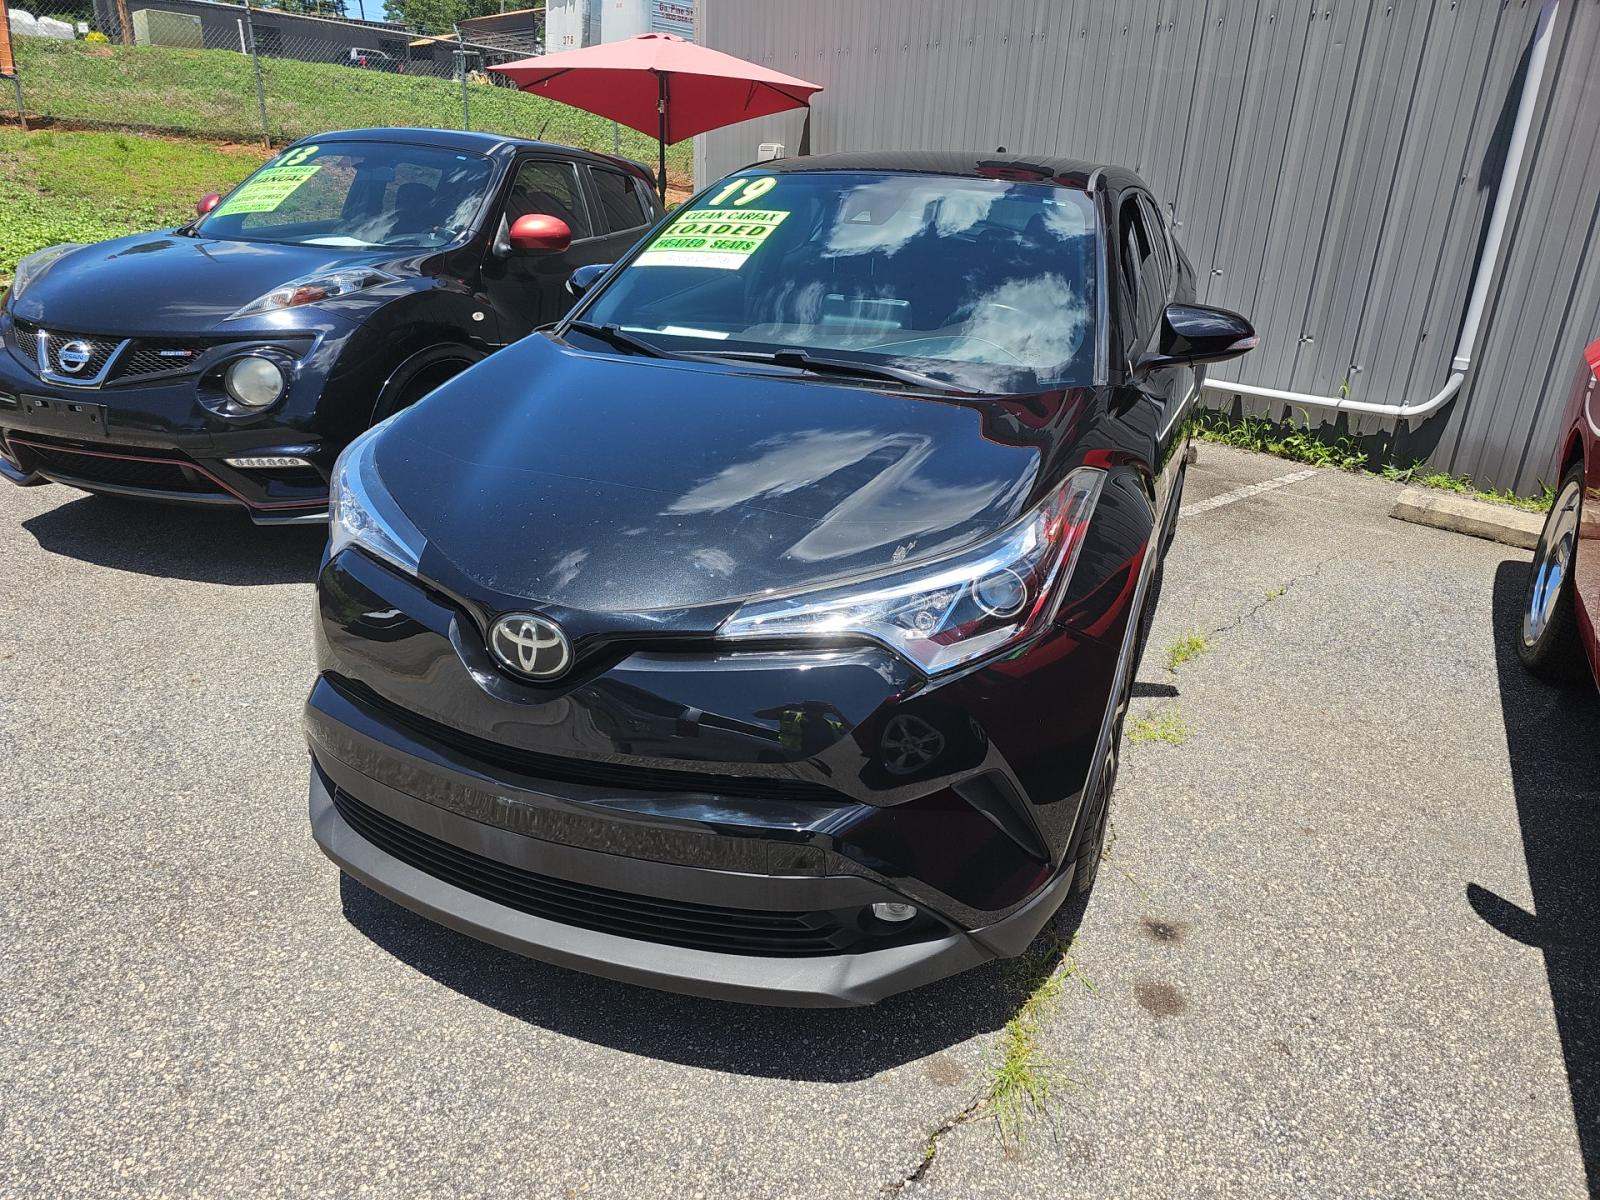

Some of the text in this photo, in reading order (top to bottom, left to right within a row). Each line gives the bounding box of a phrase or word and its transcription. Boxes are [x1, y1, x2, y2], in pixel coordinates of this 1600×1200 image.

[274, 146, 319, 167] 13
[709, 177, 777, 206] 19
[686, 211, 780, 222] CLEAN CARFAX
[667, 224, 766, 236] LOADED
[654, 239, 756, 250] HEATED SEATS
